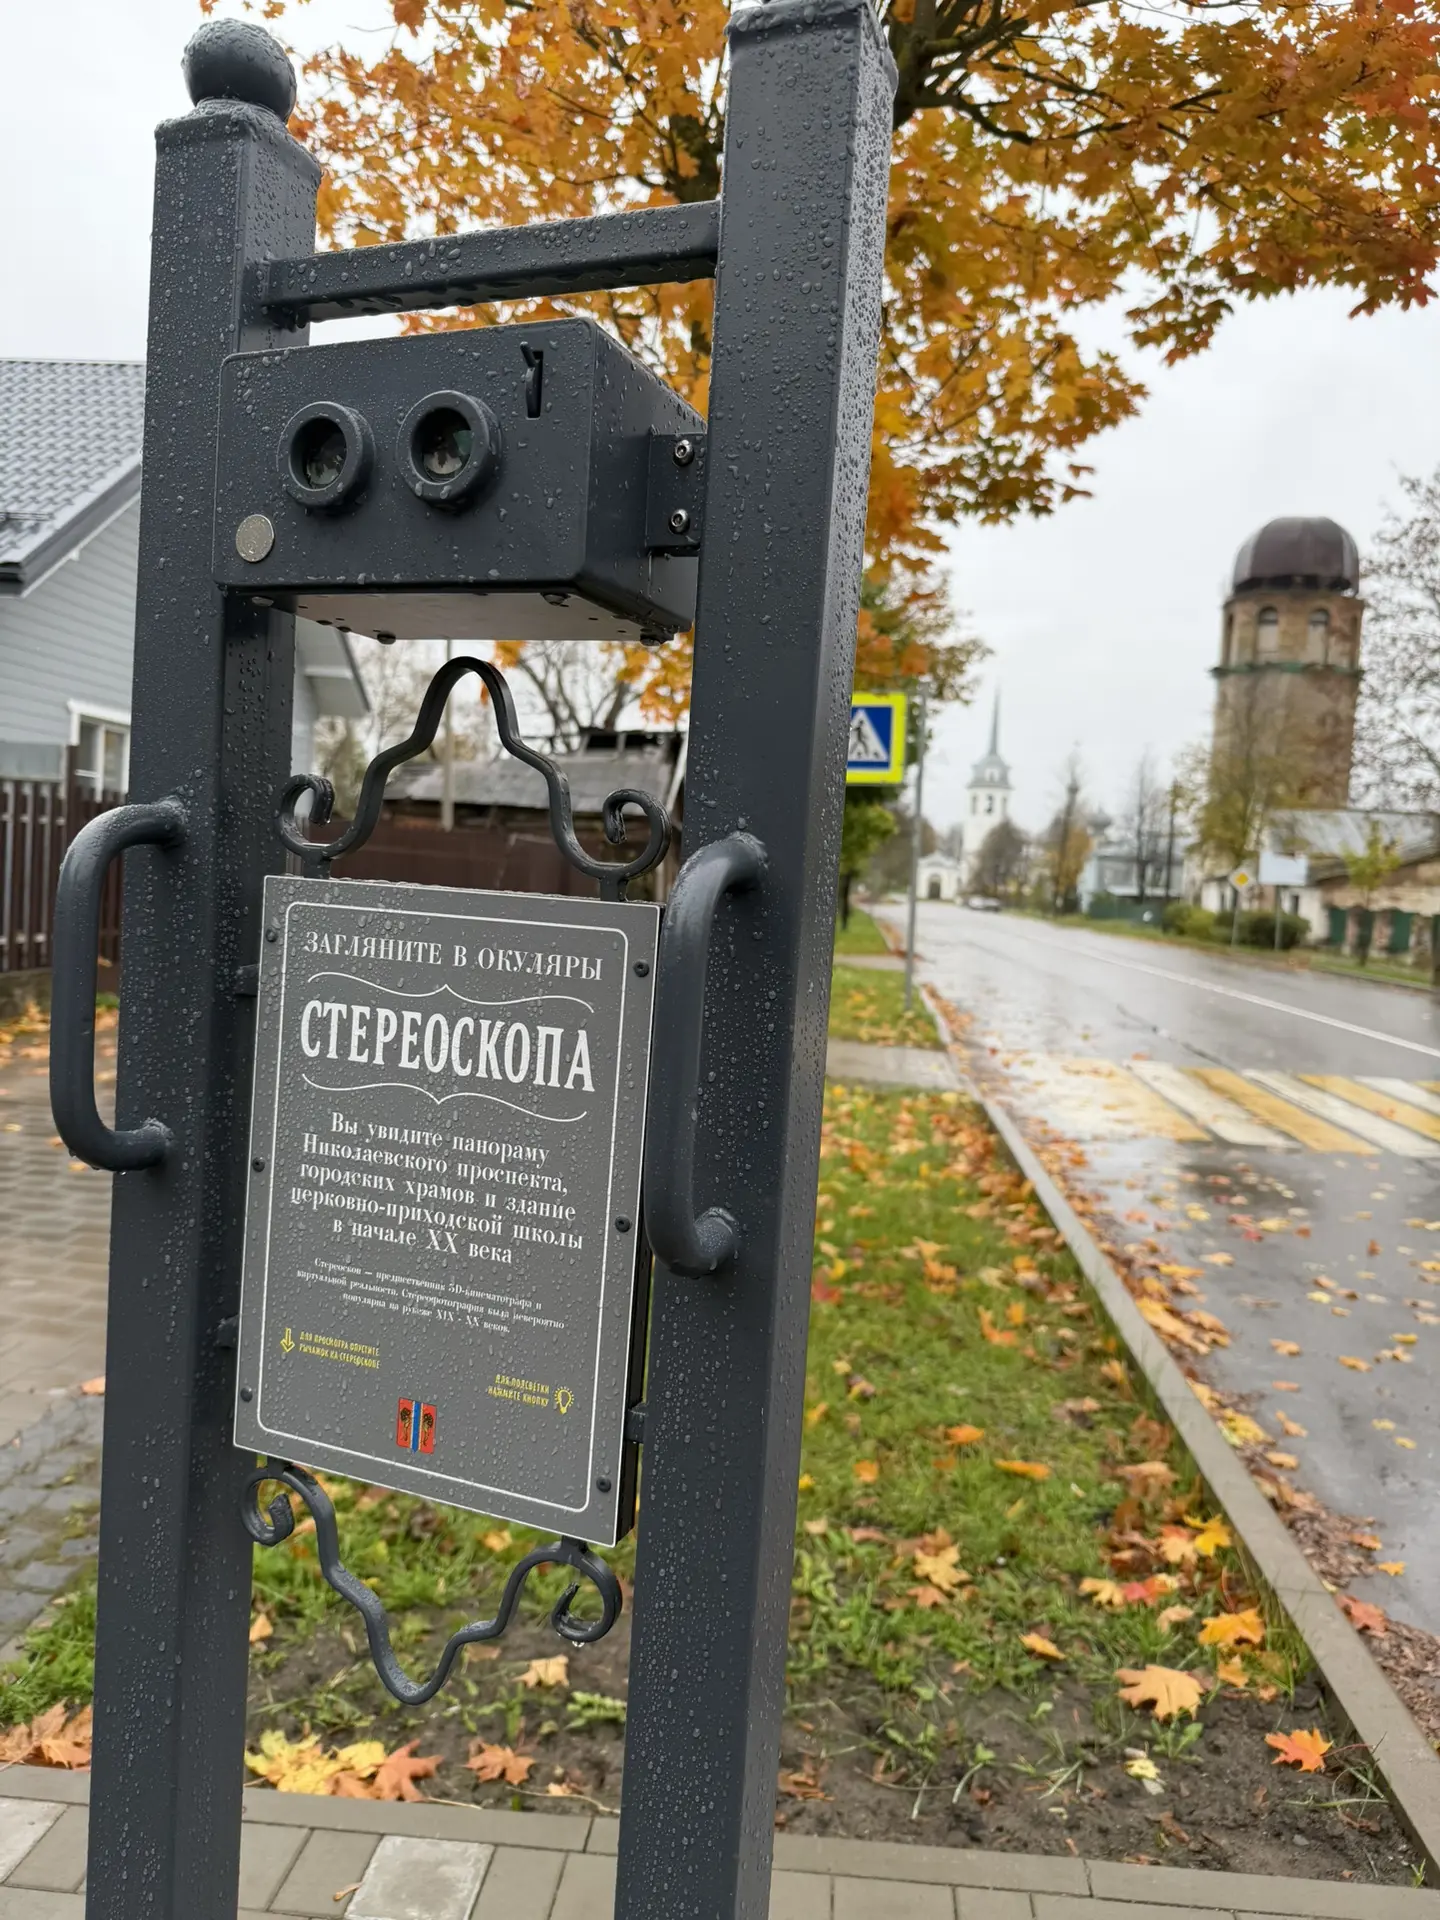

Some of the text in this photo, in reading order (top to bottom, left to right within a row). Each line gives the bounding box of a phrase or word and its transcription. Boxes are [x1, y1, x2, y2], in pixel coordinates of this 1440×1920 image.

[304, 931, 603, 981] ЗАГЛЯНИТЕ В ОКУЛЯРЫ
[301, 1000, 595, 1092] СТЕРЕОСКОПА
[302, 1132, 568, 1197] Николаевского проспекта,
[331, 1112, 550, 1169] Вы увидите панораму
[290, 1186, 583, 1250] церковно-приходской школы
[300, 1162, 576, 1222] городских храмов и здание
[314, 1257, 362, 1275] Стереоскоп
[333, 1218, 343, 1234] в
[351, 1221, 417, 1247] начале
[468, 1240, 513, 1264] века
[296, 1269, 347, 1286] виртуальной
[401, 1288, 485, 1314] Стереофотография
[513, 1312, 565, 1329] невероятно
